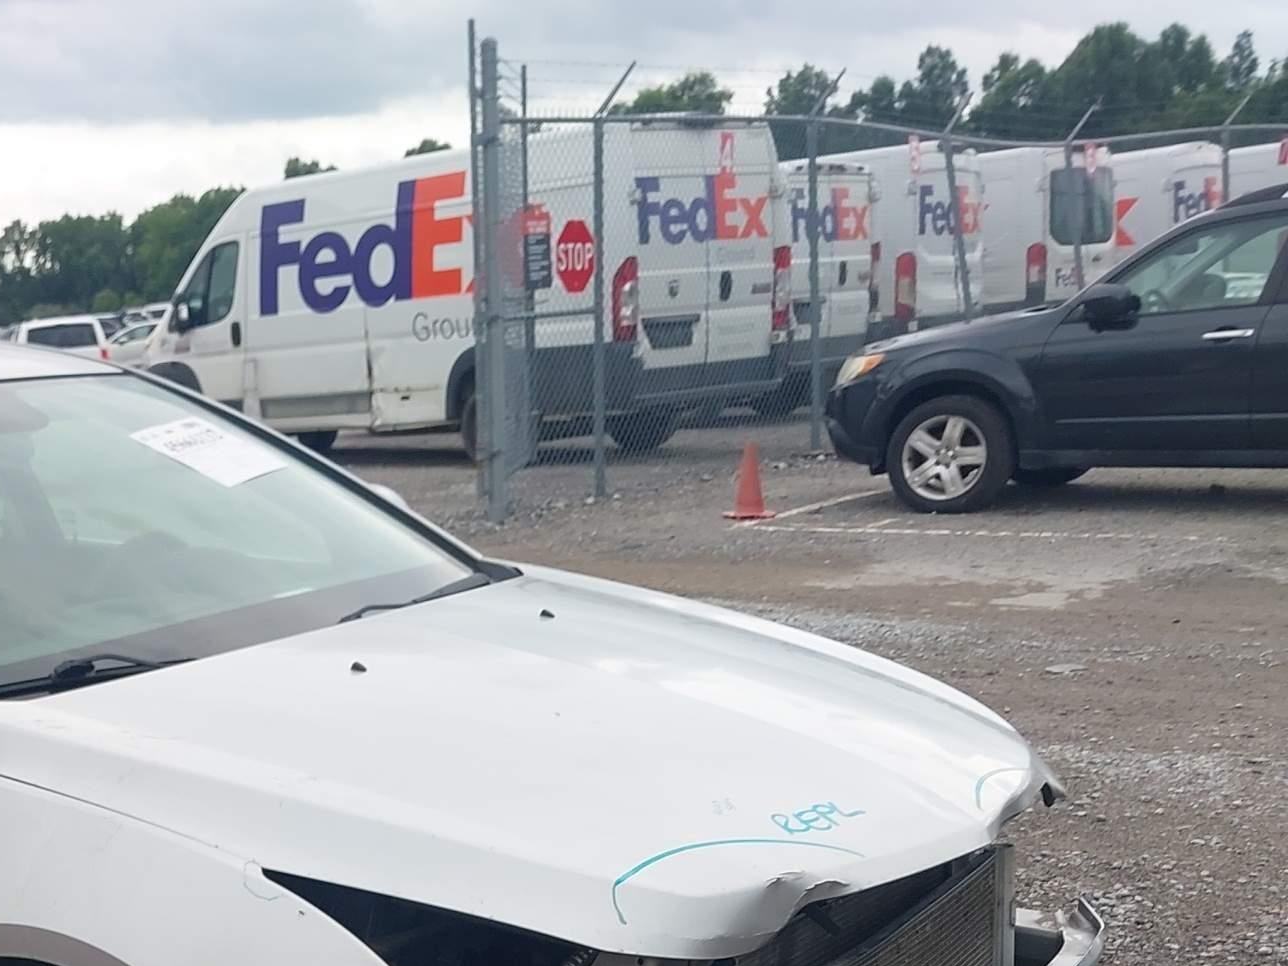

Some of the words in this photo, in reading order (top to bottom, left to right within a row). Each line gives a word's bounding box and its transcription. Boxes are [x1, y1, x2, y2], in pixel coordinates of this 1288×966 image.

[634, 176, 769, 245] FedEx
[260, 171, 475, 316] FedE
[558, 242, 593, 272] STOP
[412, 312, 472, 342] Grou
